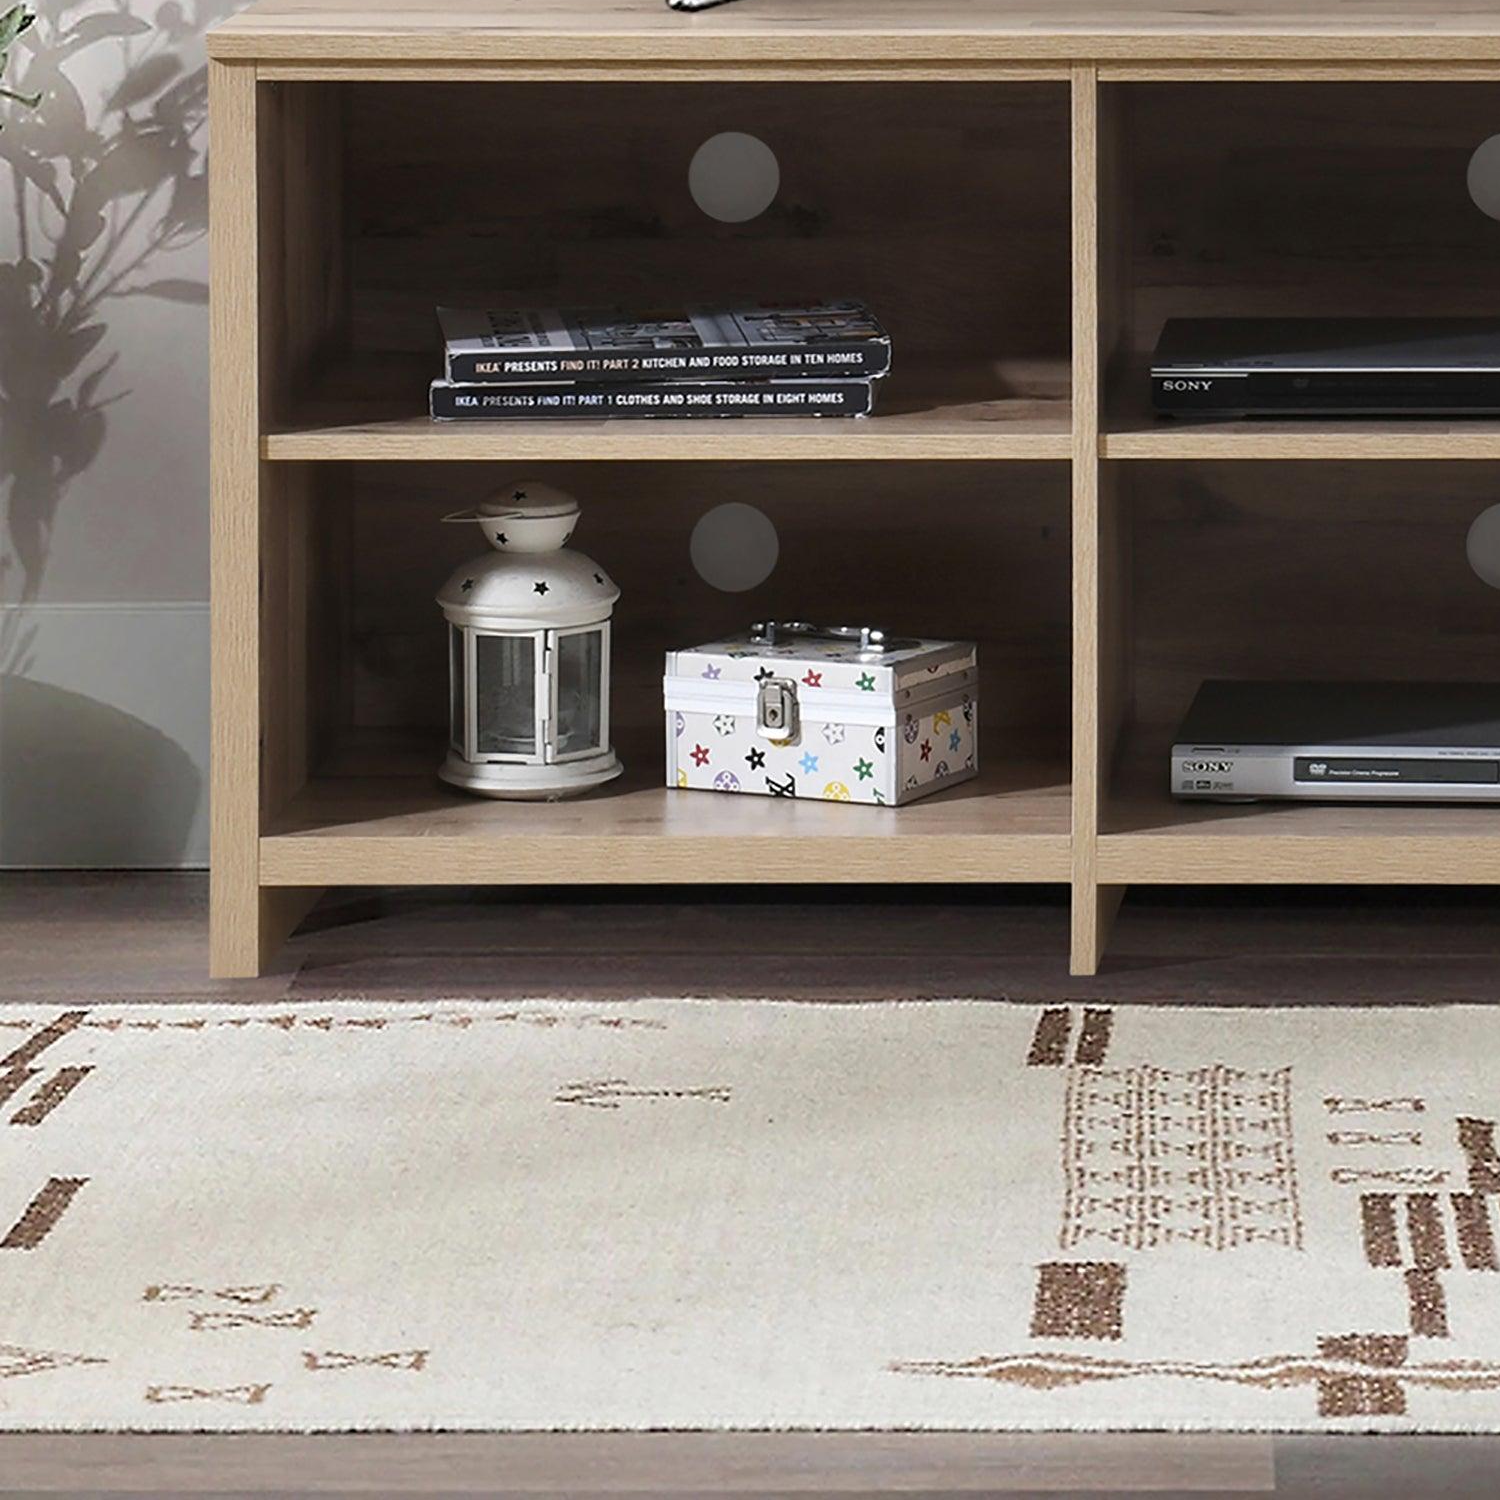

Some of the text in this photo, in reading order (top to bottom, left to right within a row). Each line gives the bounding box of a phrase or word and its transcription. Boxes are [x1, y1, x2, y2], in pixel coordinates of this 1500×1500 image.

[475, 352, 864, 373] IKEA PRESENTS FIND IT! PART 2 KITCHEN AND FOOD STORAGE IN TEN HOMES
[1162, 380, 1212, 391] SONY
[455, 393, 844, 406] IKEA PRESENTS FIND IT! PART 1 CLOTHES AND SHOE STORAGE IN EIGHT HOMES
[1182, 760, 1234, 773] SONY
